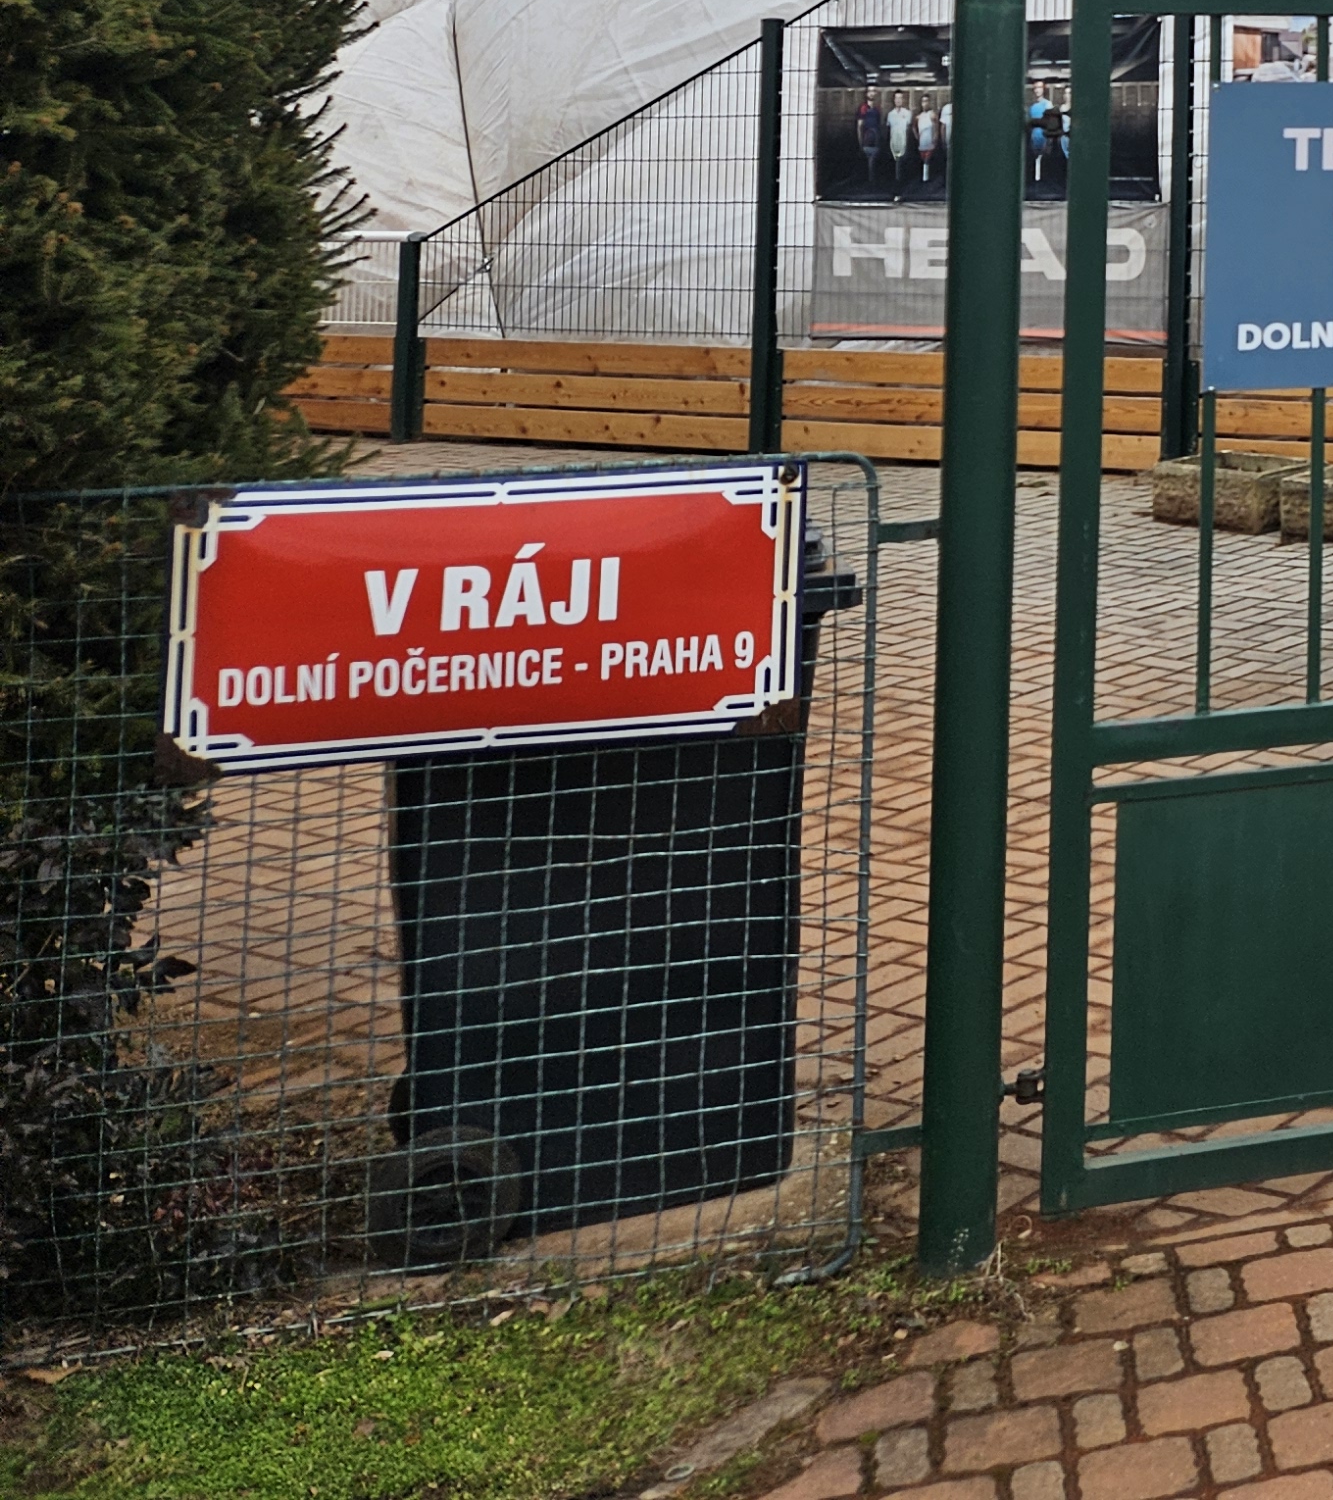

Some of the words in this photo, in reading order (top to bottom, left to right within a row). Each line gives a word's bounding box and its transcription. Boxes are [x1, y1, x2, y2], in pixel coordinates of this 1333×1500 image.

[364, 568, 418, 636] V
[440, 542, 620, 632] RÁJI
[218, 652, 336, 708] DOLNÍ
[349, 646, 562, 698] POČERNICE
[600, 634, 723, 681] PRAHA
[734, 631, 755, 670] 9
